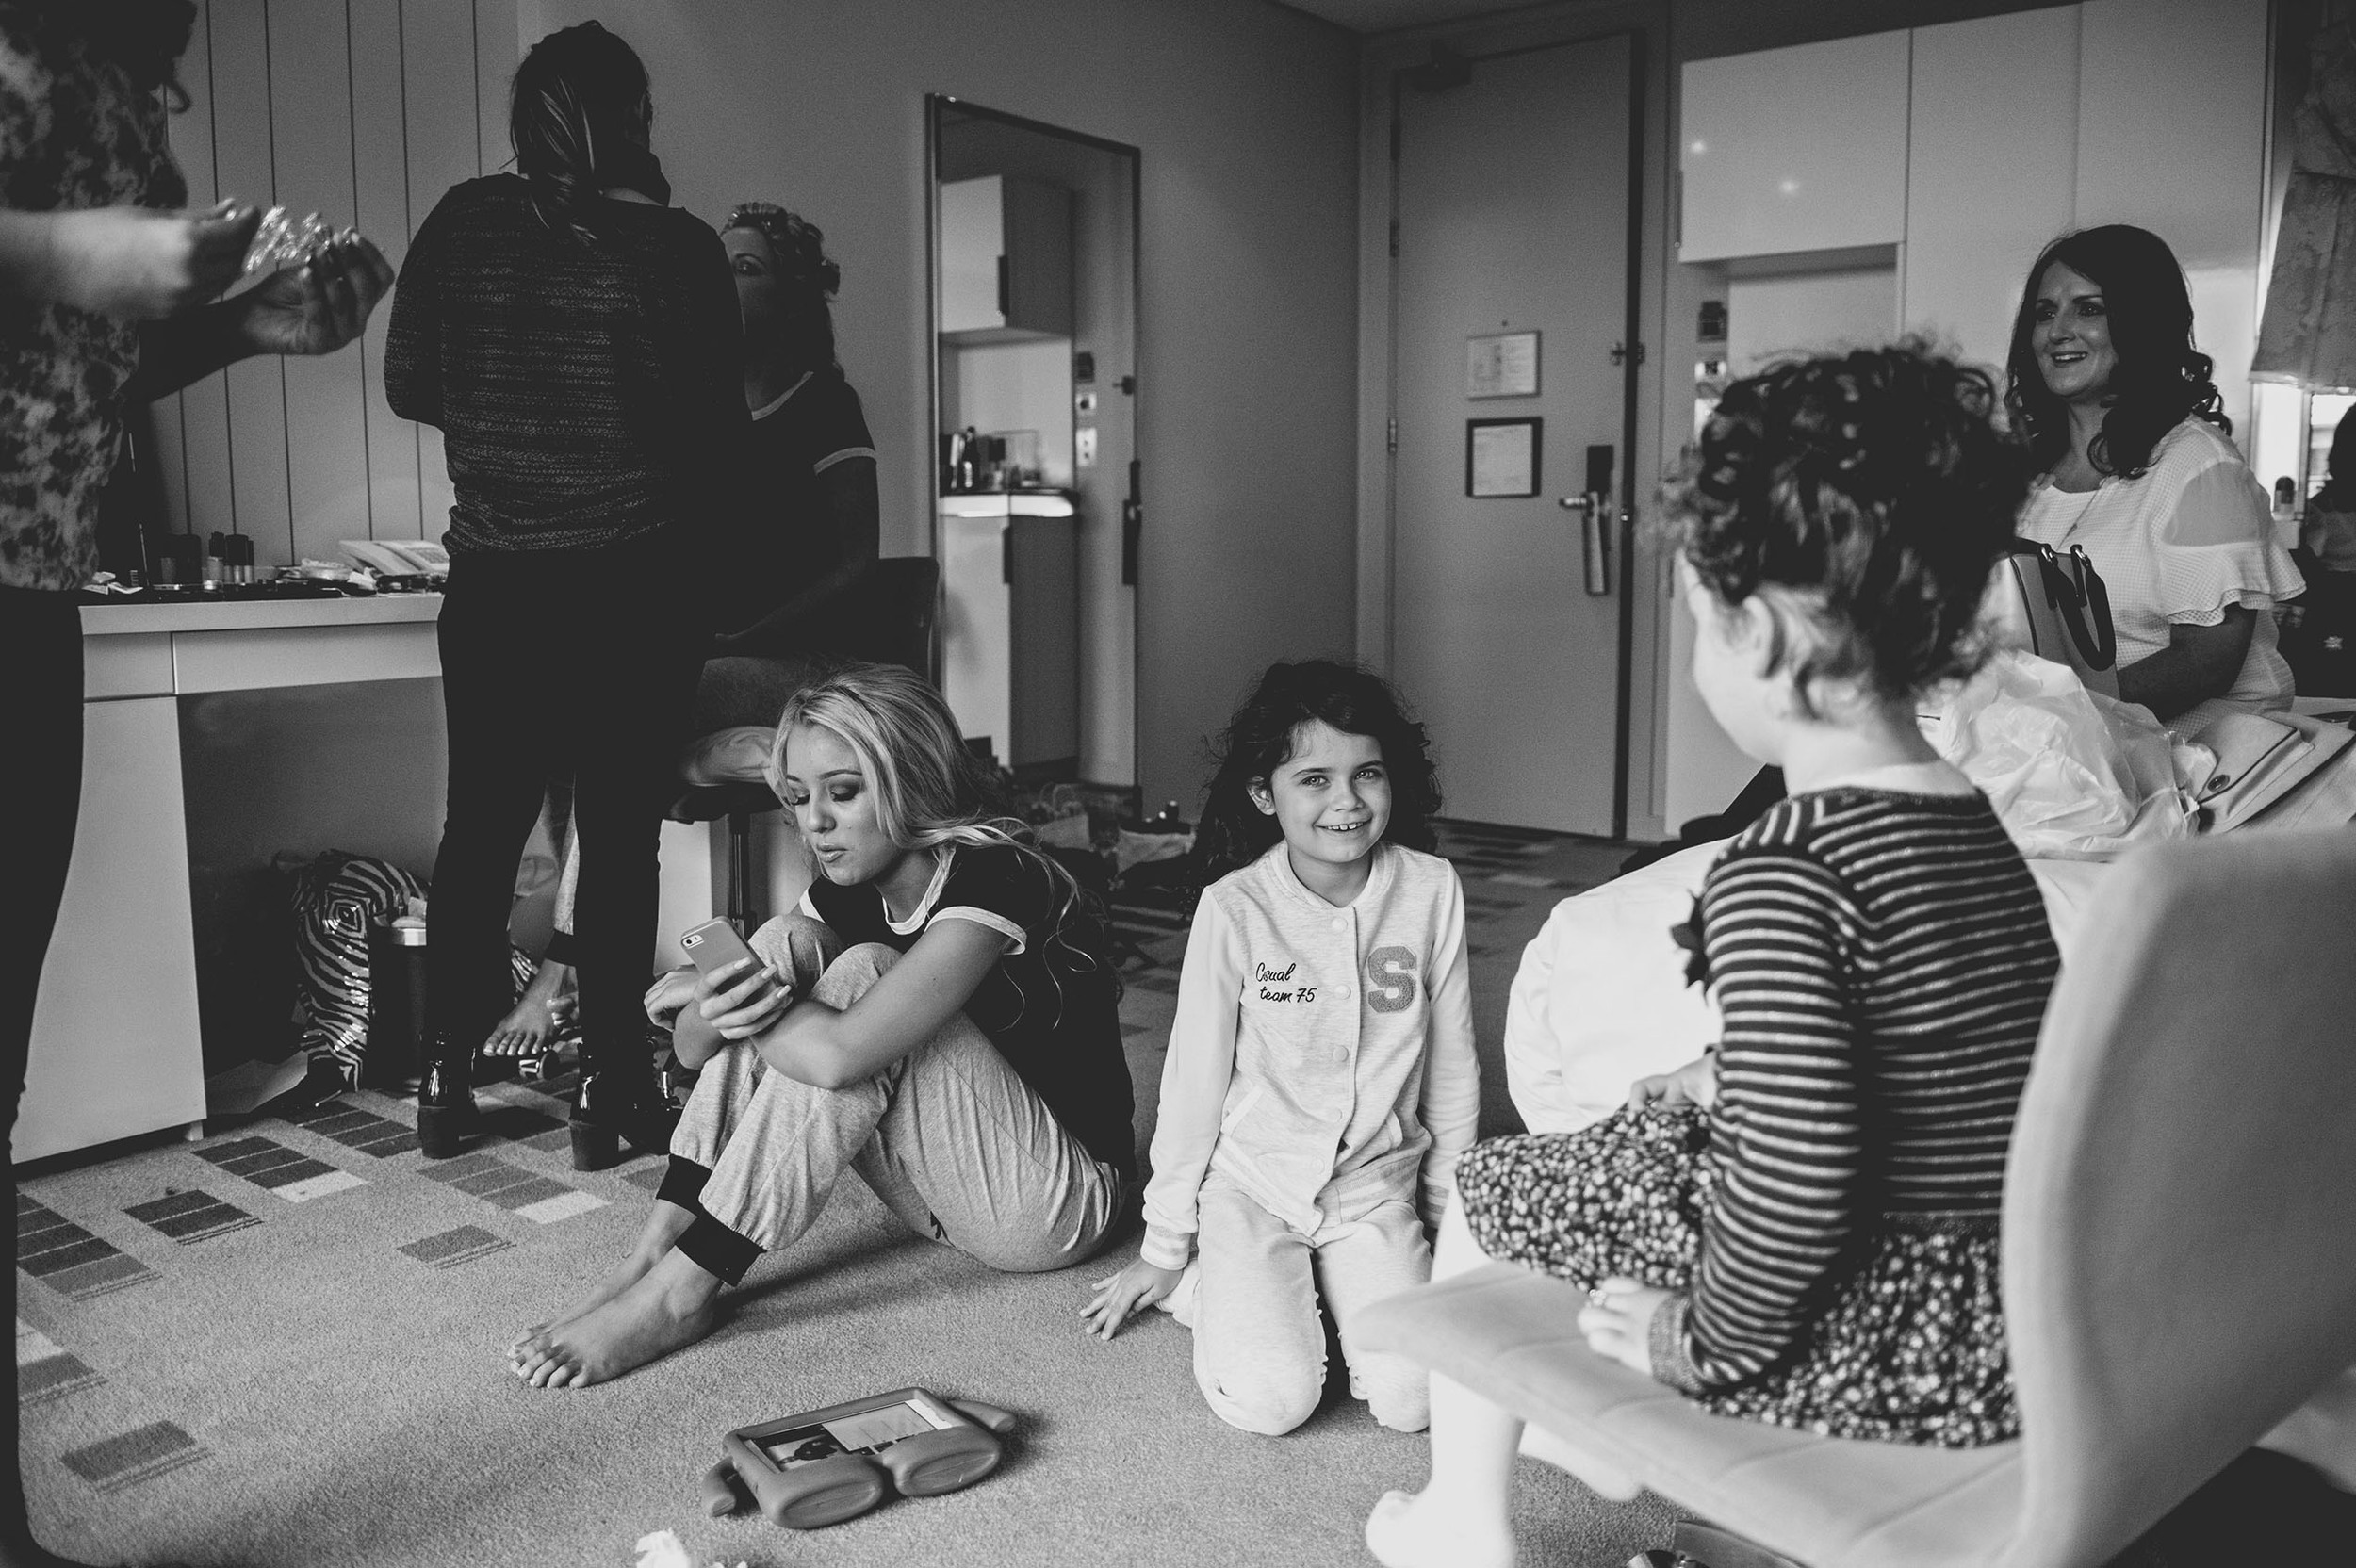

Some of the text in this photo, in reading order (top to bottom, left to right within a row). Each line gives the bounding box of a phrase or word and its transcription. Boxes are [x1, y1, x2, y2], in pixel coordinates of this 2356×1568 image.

[1260, 986, 1317, 1003] team 75
[1367, 945, 1417, 1014] S
